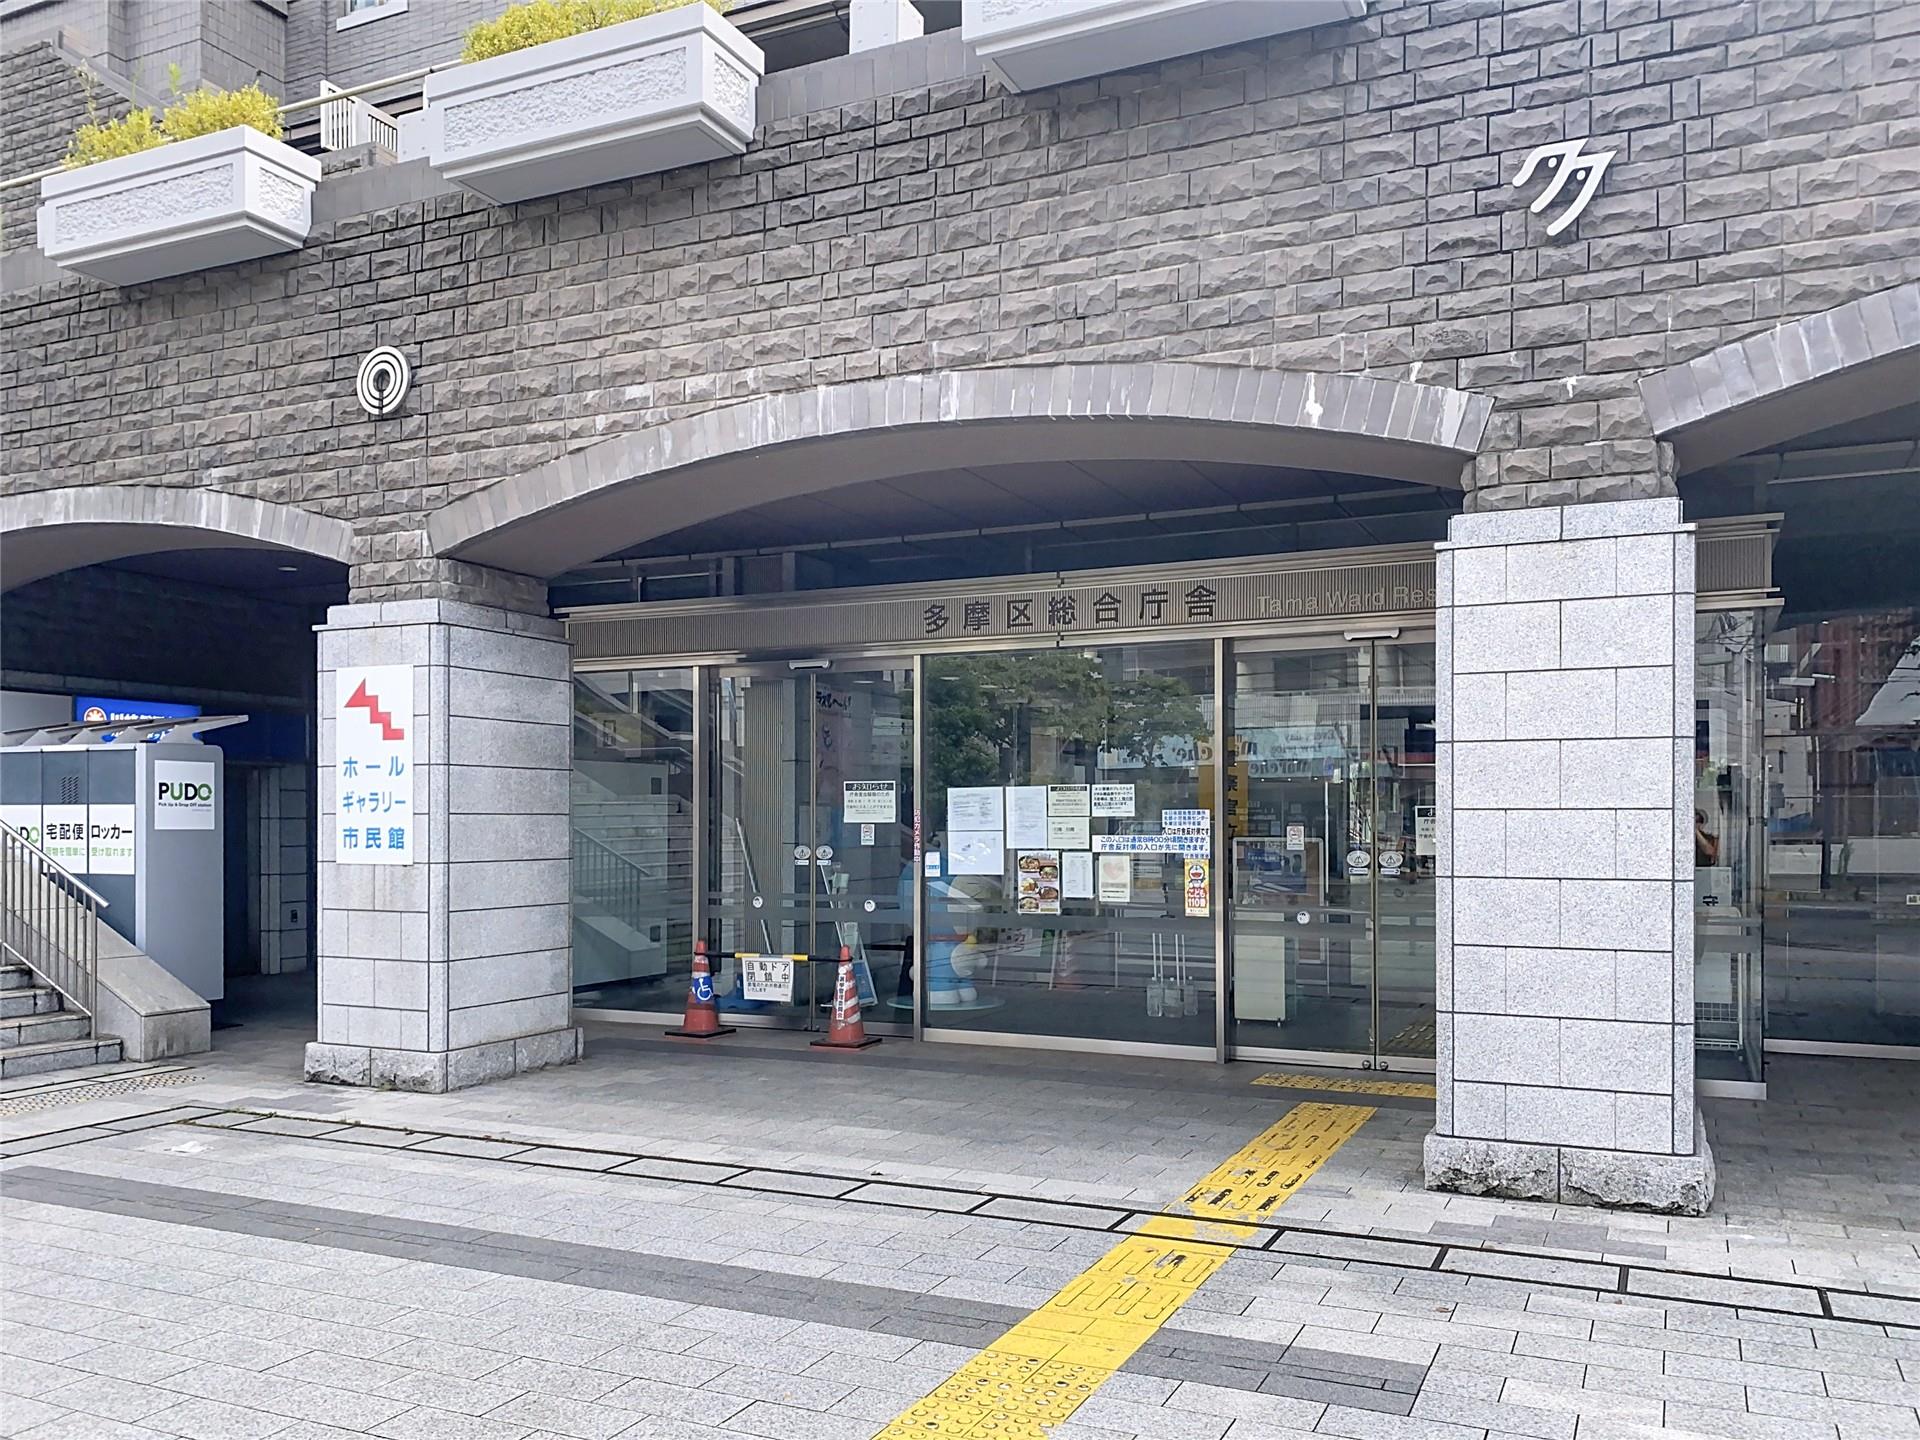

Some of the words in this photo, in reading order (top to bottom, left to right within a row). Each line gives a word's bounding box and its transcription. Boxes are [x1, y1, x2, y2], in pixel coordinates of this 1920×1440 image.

[923, 584, 1217, 634] 多摩区総合庁舎
[1256, 595, 1319, 616] Tama
[1326, 587, 1385, 609] Ward
[342, 755, 405, 779] ホール
[158, 782, 212, 801] PUDO
[851, 783, 889, 791] お知らせ
[342, 791, 407, 814] ギャラリー
[46, 823, 84, 841] 宅配便
[91, 824, 133, 840] ロッカー
[342, 826, 405, 850] 市民館
[1188, 888, 1206, 898] こども
[747, 961, 790, 973] 自動ドア
[746, 972, 789, 983] 閉鎖中
